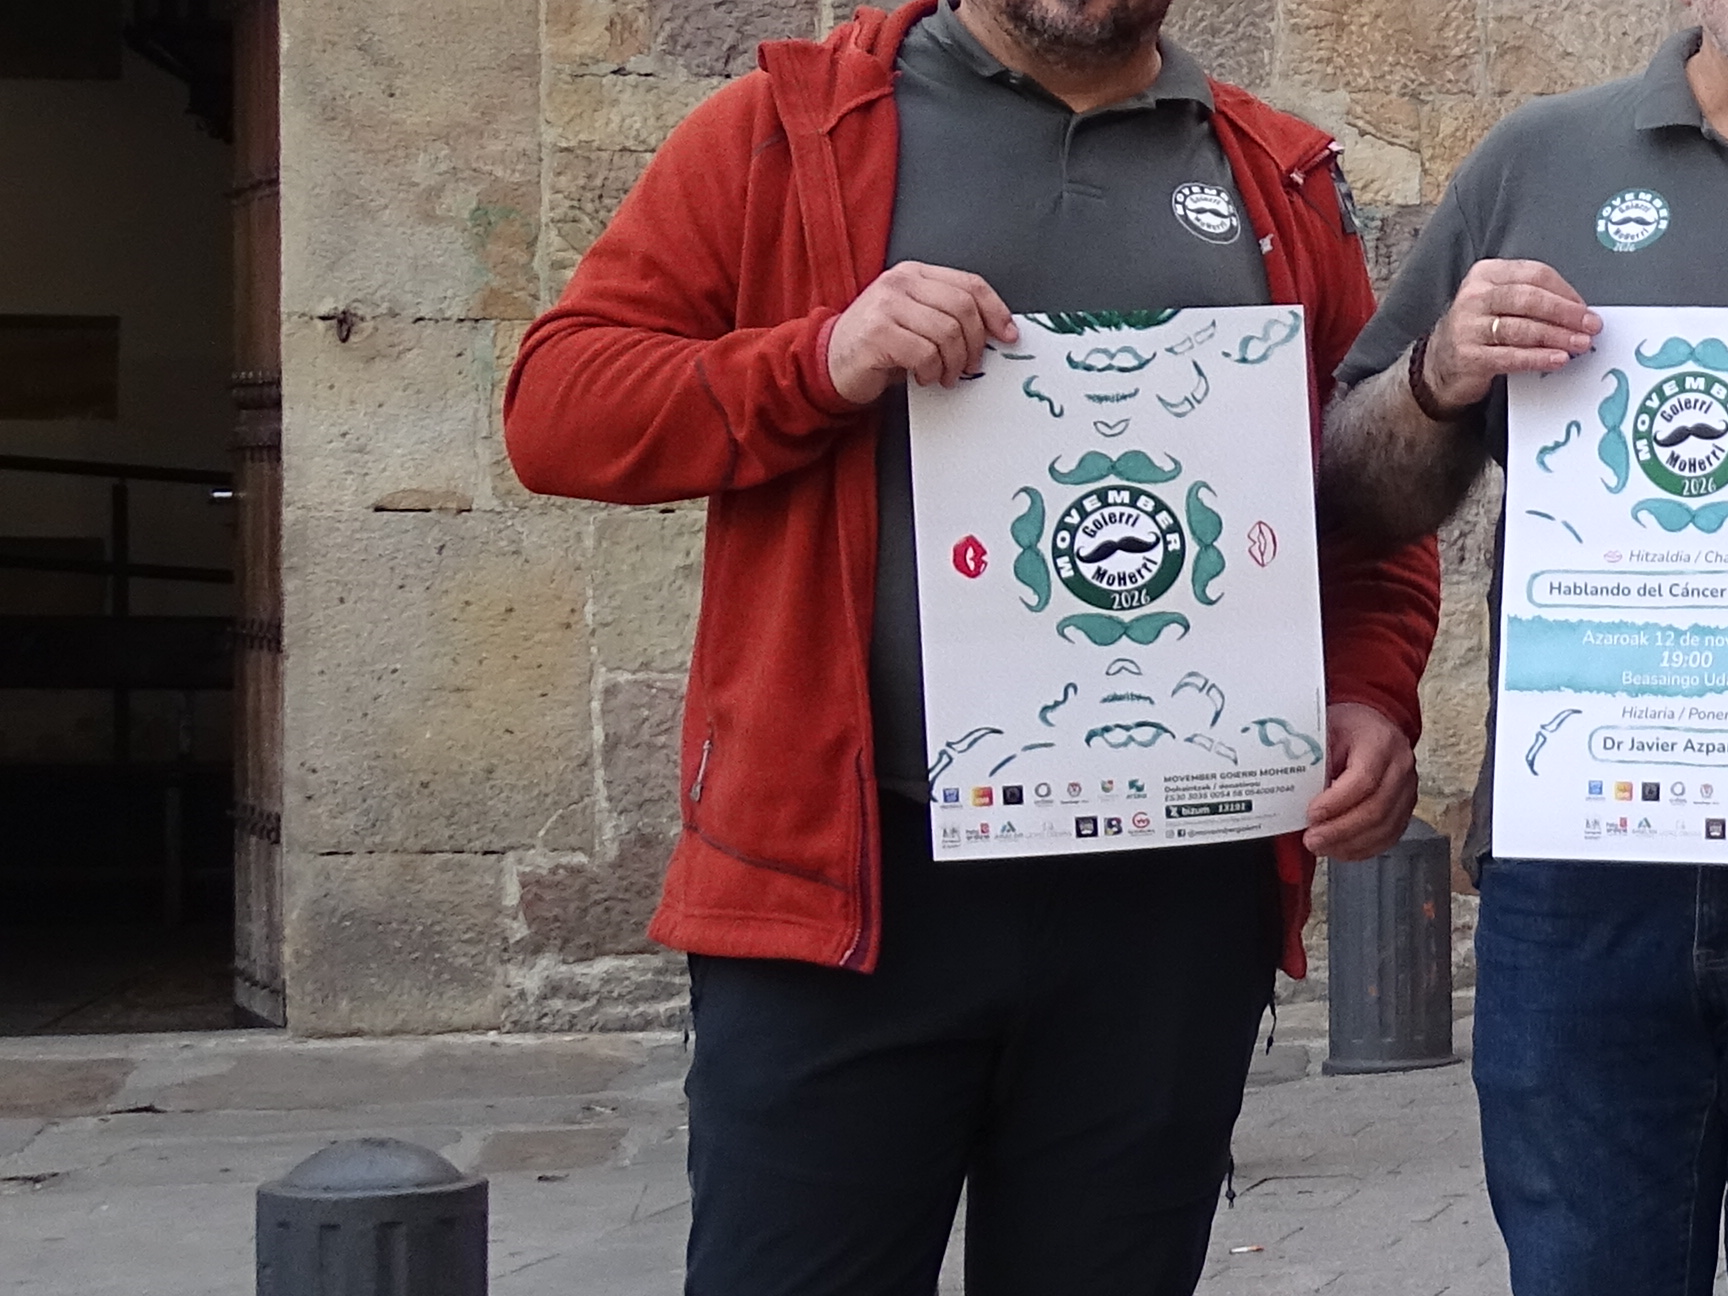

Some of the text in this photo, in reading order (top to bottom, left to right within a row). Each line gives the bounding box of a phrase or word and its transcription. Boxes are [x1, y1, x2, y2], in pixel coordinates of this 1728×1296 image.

[1597, 192, 1668, 232] MOVEMBER
[1660, 398, 1713, 423] Goierri
[1666, 444, 1725, 473] MoHerri
[1682, 477, 1716, 495] 2026
[1082, 512, 1140, 538] Goierri
[1056, 490, 1180, 578] MOVEMBER
[1629, 551, 1690, 564] Hitzaldia
[1092, 556, 1158, 586] MoHerri
[1549, 582, 1631, 597] Hablando
[1637, 583, 1663, 597] del
[1669, 584, 1726, 598] Cáncer
[1111, 589, 1150, 609] 2026
[1583, 631, 1648, 646] Azaroak
[1655, 632, 1674, 646] 12
[1680, 632, 1699, 646] de
[1660, 652, 1712, 668] 19:00
[1622, 672, 1698, 688] Beasaingo
[1622, 707, 1674, 720] Hizlaria
[1603, 737, 1623, 751] Dr
[1628, 737, 1678, 752] Javier
[1182, 806, 1210, 815] bizum
